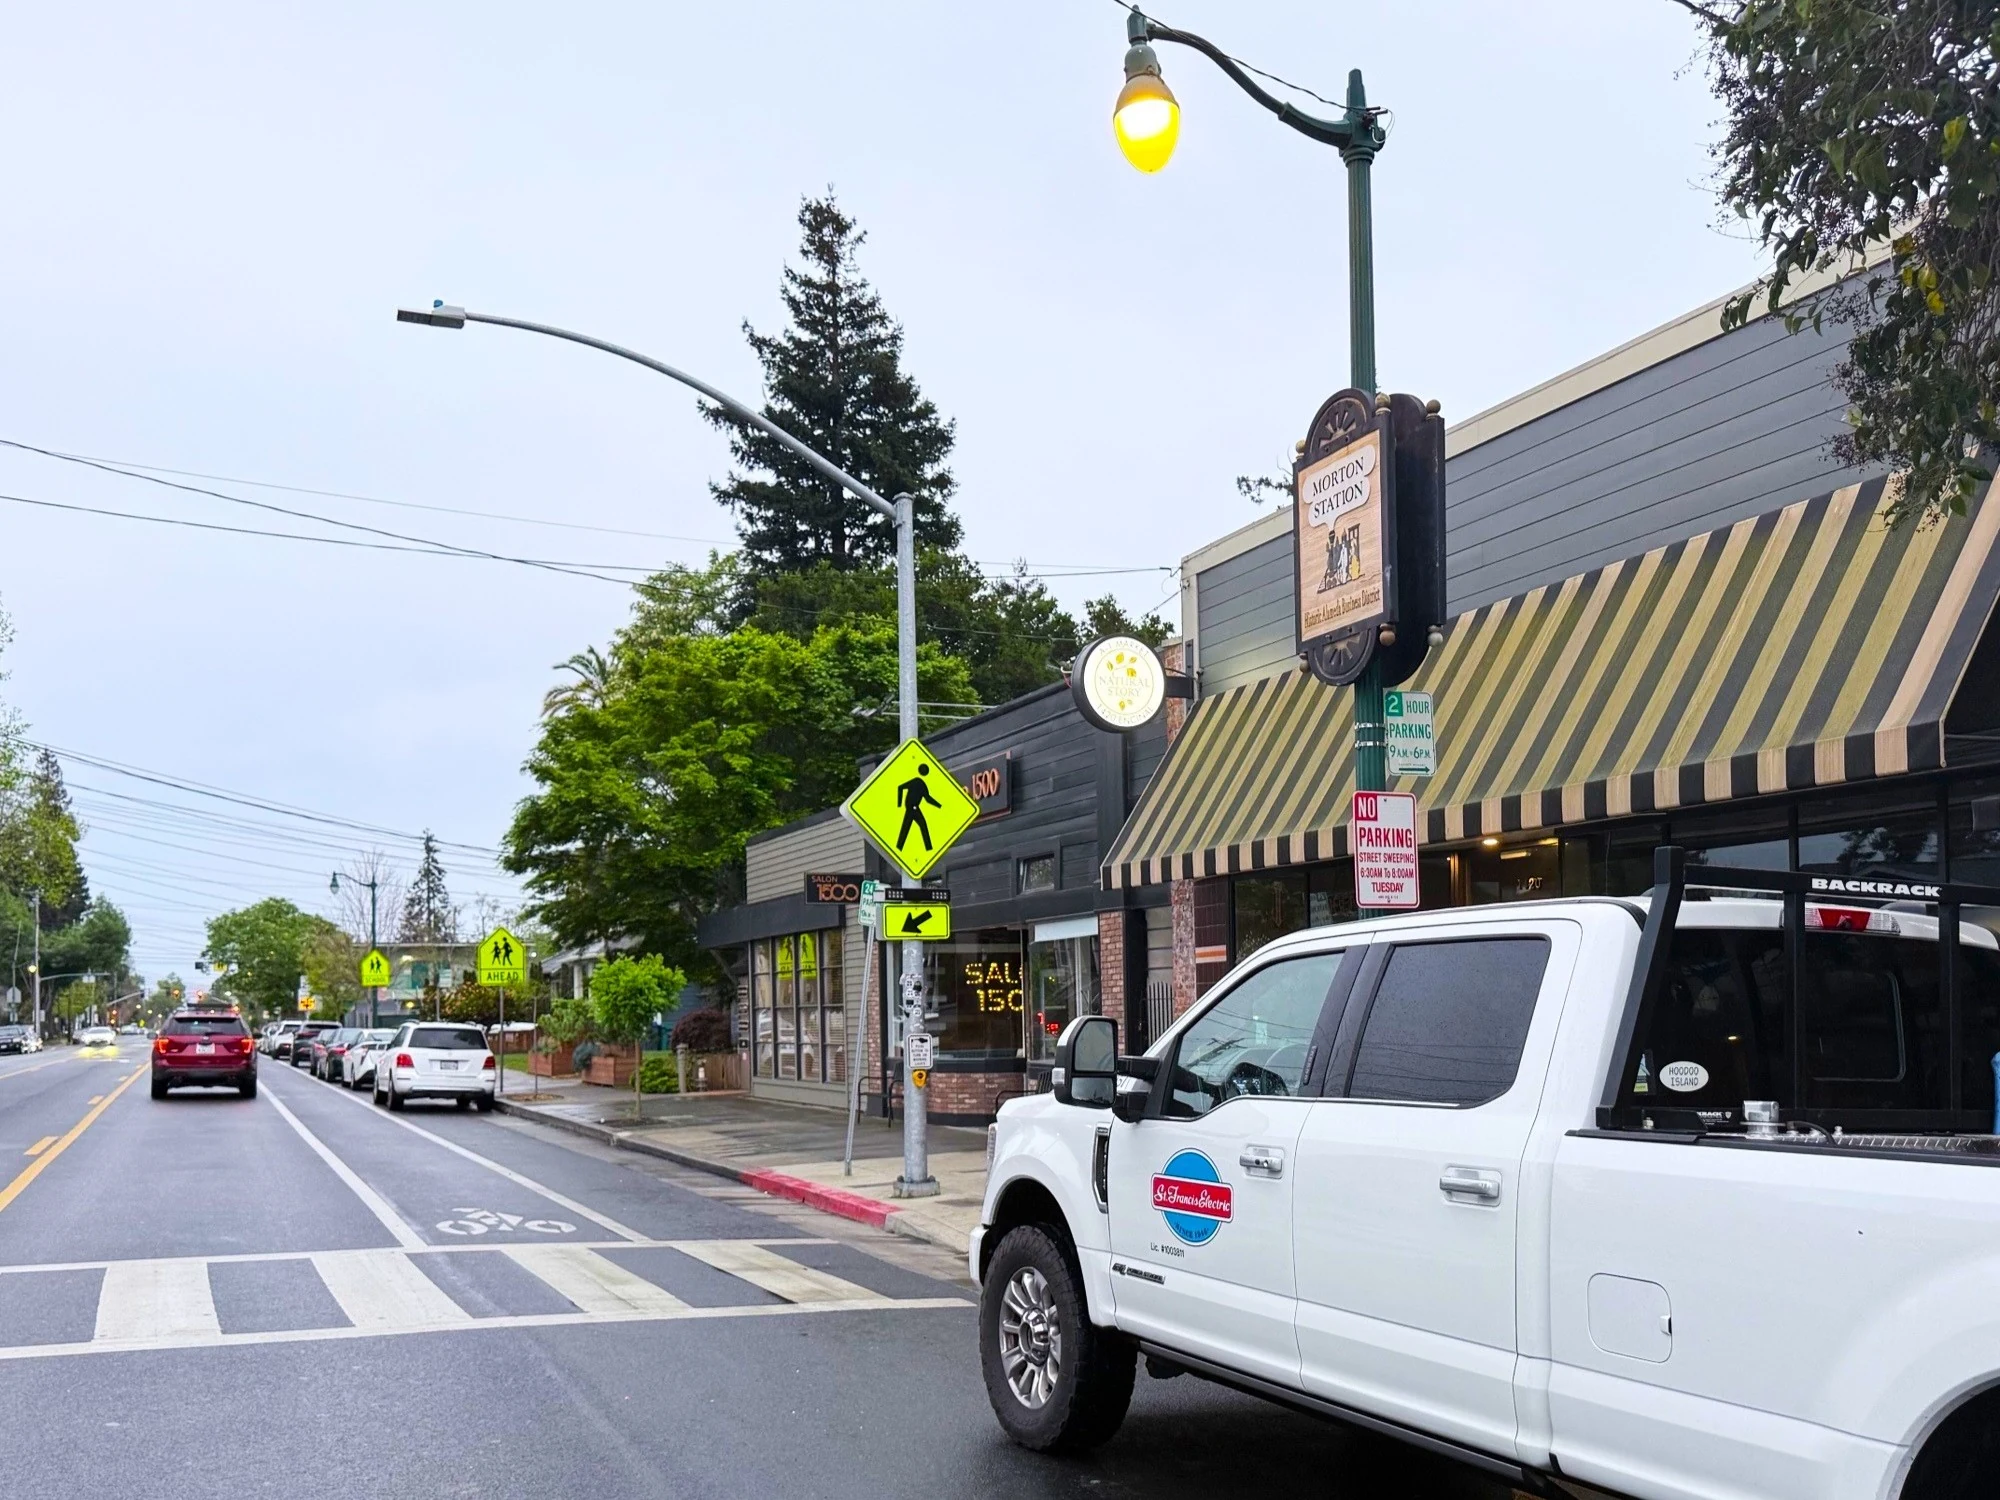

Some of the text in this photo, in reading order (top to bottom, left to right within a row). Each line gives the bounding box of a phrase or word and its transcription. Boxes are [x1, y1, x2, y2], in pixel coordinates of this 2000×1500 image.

[1312, 456, 1364, 497] MORTON
[1313, 480, 1363, 519] STATION
[1341, 596, 1362, 614] Business
[1362, 588, 1380, 607] District
[1099, 675, 1151, 688] NATURAL
[1107, 687, 1141, 697] STORY
[1387, 695, 1430, 715] 2 HOUR
[1389, 722, 1432, 740] PARKING
[972, 768, 1000, 800] 1500
[1358, 801, 1376, 819] NO
[1359, 827, 1413, 849] PARKING
[1359, 853, 1414, 864] STREET SWEEPING
[811, 874, 838, 883] SALON
[1360, 868, 1383, 878] 6:30AM
[1391, 868, 1414, 878] 8:00AM
[817, 884, 859, 902] 1500
[1371, 882, 1404, 893] TUESDAY
[1812, 878, 1940, 897] BACKRACK
[487, 972, 519, 981] AHEAD
[965, 962, 1023, 985] SAL
[1668, 1066, 1699, 1076] HOODOO
[1671, 1077, 1699, 1087] ISLAND
[1154, 1184, 1231, 1211] St. Francis Electric
[1151, 1242, 1159, 1252] Lic.
